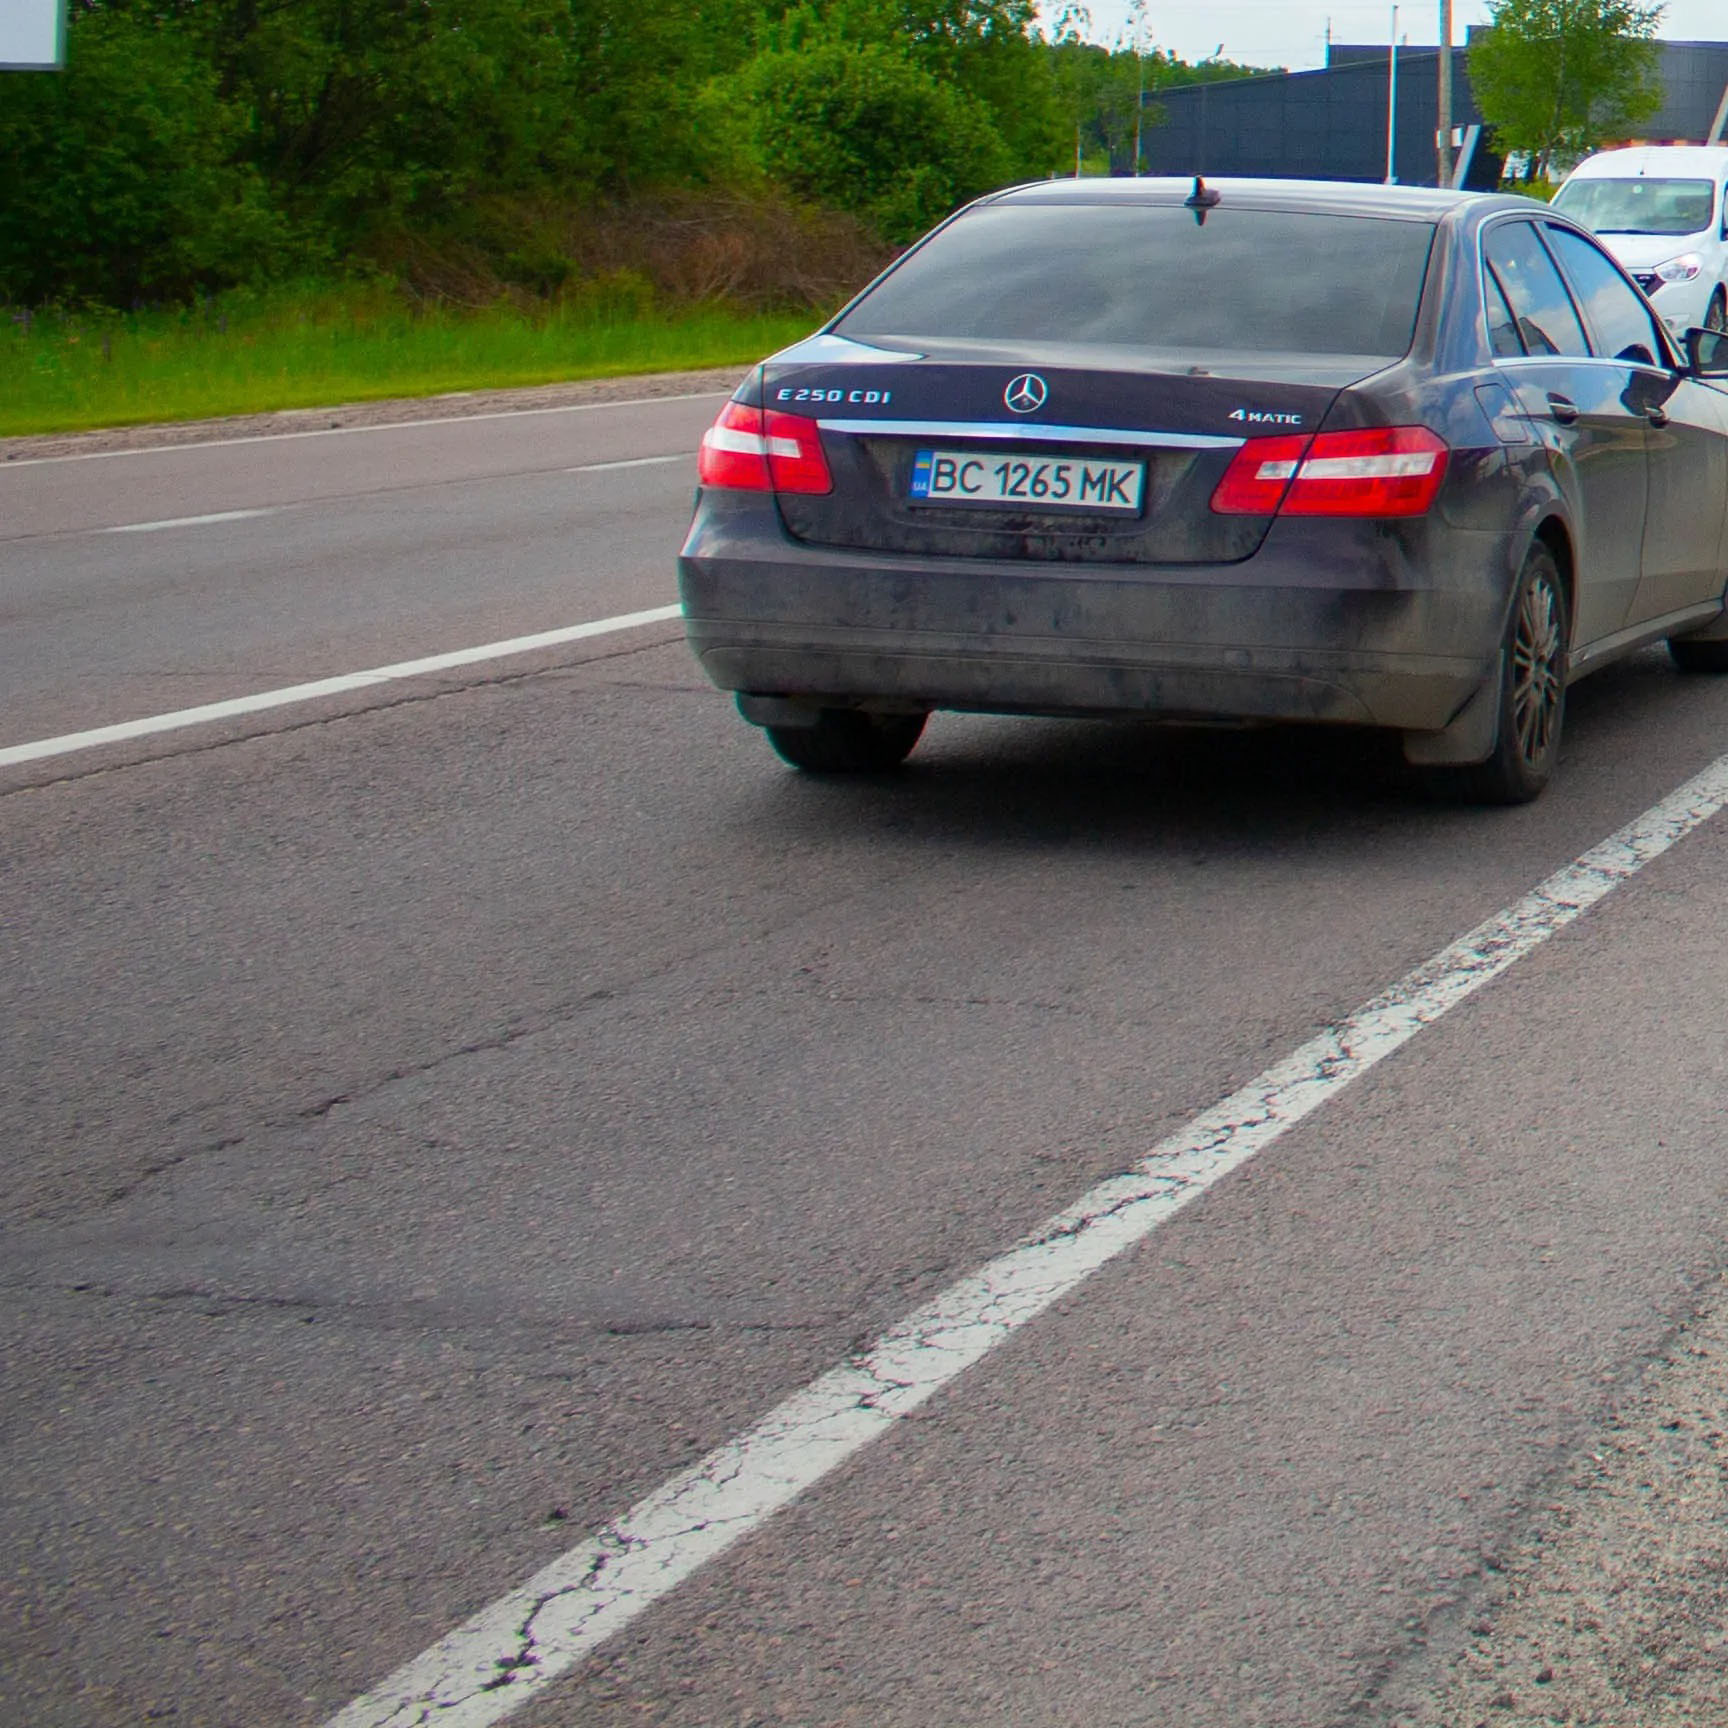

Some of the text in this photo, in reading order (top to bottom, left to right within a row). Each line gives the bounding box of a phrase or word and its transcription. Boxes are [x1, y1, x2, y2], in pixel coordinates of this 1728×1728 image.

[847, 390, 892, 404] CDI
[930, 458, 1136, 504] BC 1265 MK
